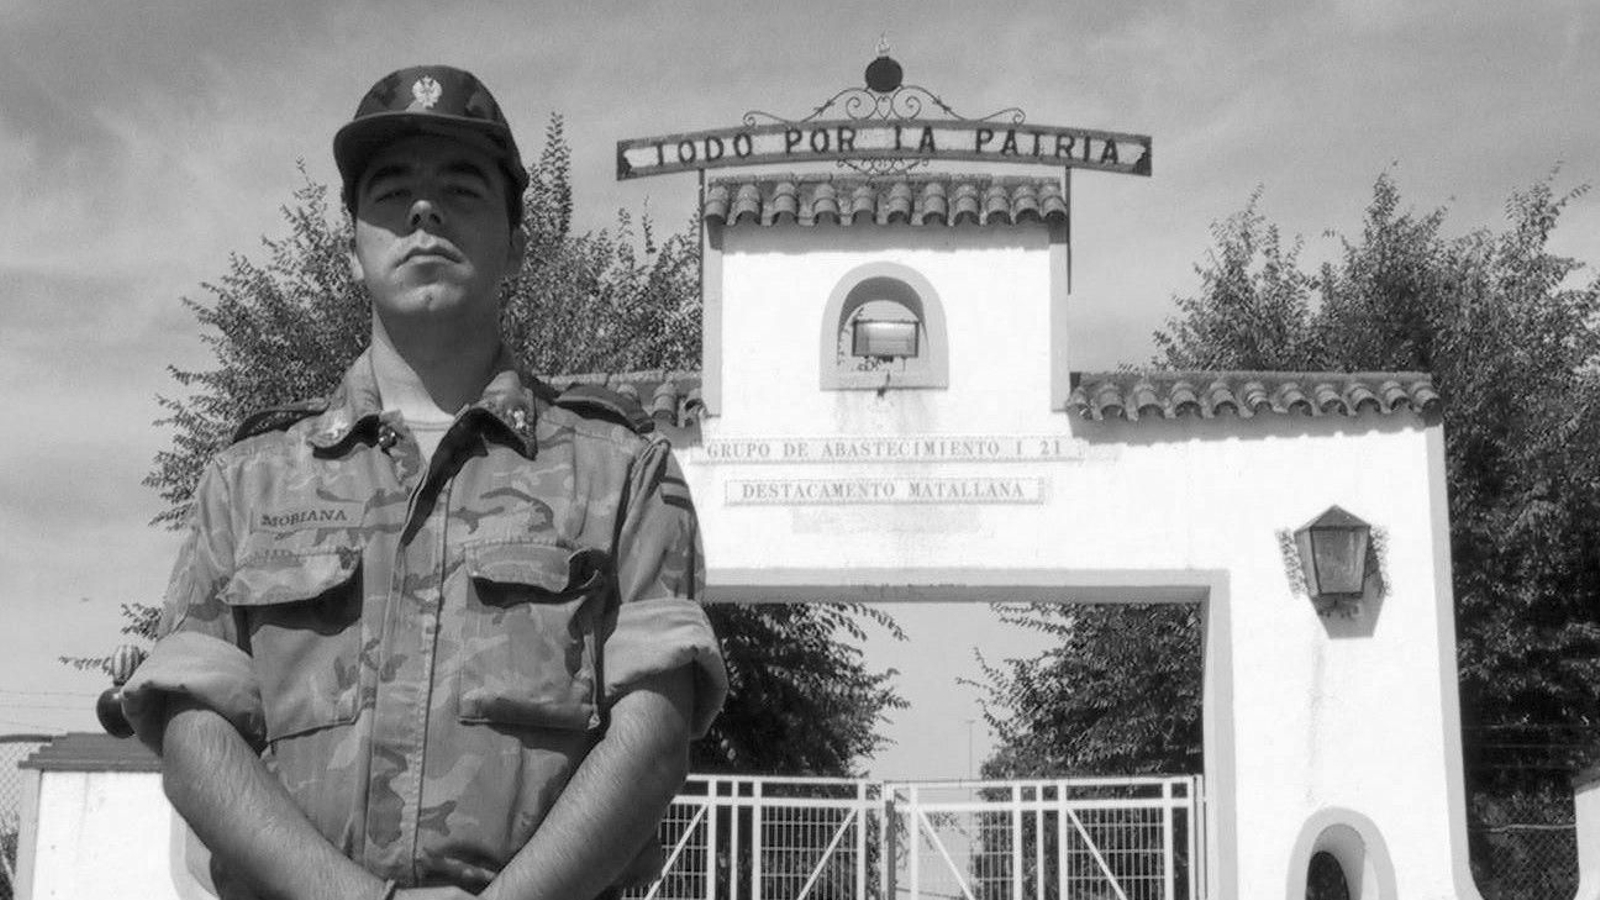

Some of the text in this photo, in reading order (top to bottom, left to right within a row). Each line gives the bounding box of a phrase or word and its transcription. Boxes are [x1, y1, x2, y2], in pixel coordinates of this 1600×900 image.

[650, 125, 1119, 167] TODO POR LA PATRIA
[706, 441, 771, 459] GRUPO
[783, 441, 810, 458] DE
[821, 439, 1000, 459] ABASTECIMIENTO
[1038, 439, 1061, 456] 21
[741, 481, 1025, 499] DESTACAMENTO MATALLANA
[260, 509, 348, 527] MORIANA
